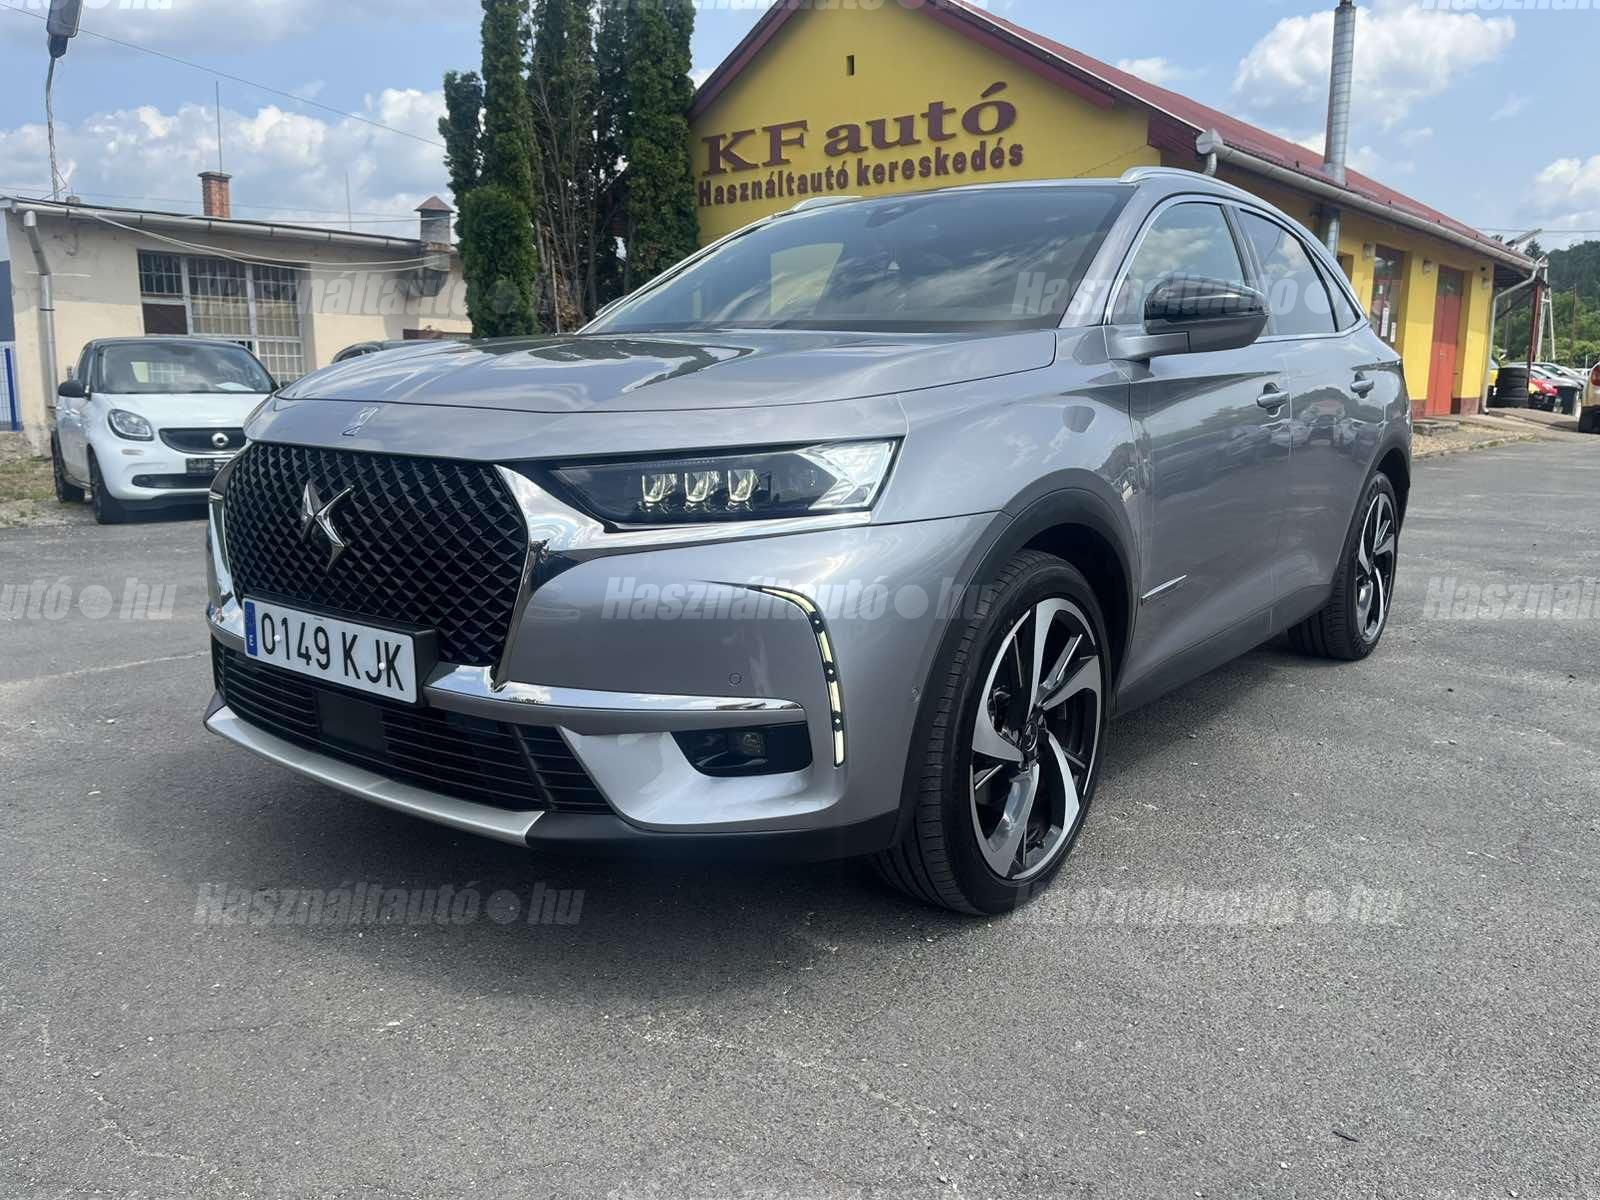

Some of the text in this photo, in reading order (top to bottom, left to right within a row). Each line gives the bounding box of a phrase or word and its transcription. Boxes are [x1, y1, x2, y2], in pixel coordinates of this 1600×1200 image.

[702, 81, 1017, 177] KF autó
[699, 137, 1024, 207] Használtautó kereskedés
[261, 612, 404, 691] 0149 KJK
